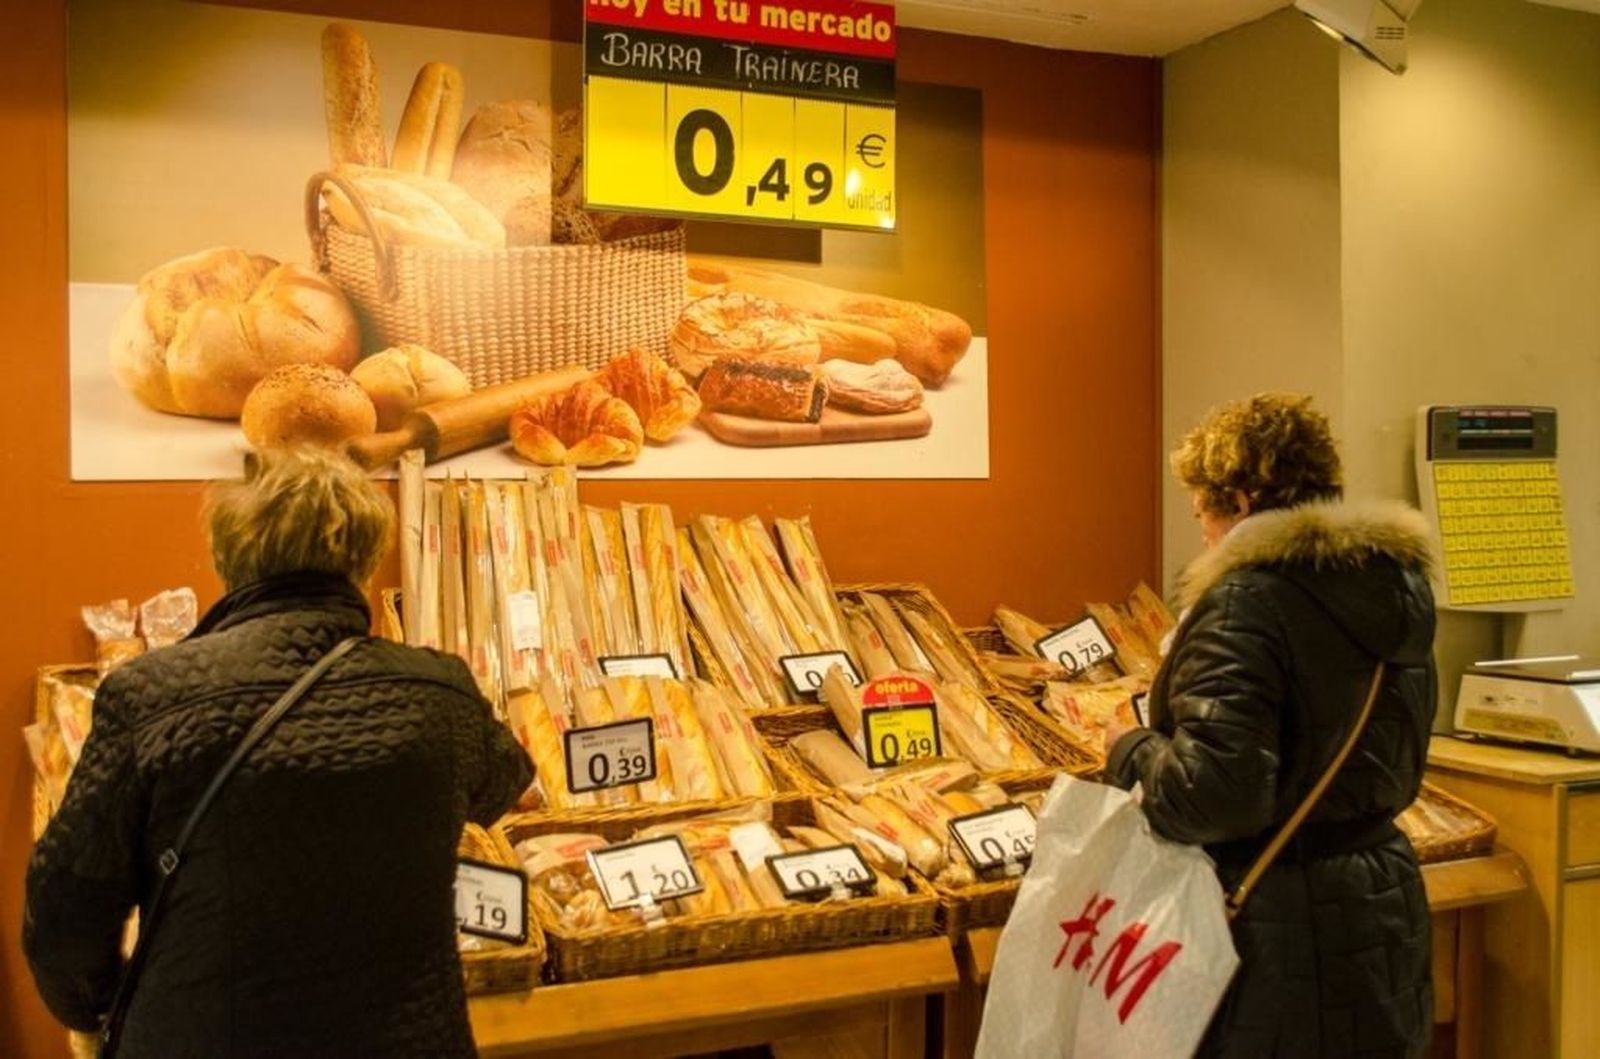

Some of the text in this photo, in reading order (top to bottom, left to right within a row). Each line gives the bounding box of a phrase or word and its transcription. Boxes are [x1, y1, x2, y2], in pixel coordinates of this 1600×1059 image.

[663, 0, 701, 18] en
[714, 0, 748, 24] tu
[760, 5, 891, 42] mercado
[601, 33, 702, 74] BARRA
[674, 109, 887, 206] 0,49 €
[847, 189, 891, 211] unidad
[1058, 643, 1104, 674] 0,79
[875, 680, 919, 696] oferta
[881, 733, 932, 767] 0,49
[588, 753, 646, 784] 0,39
